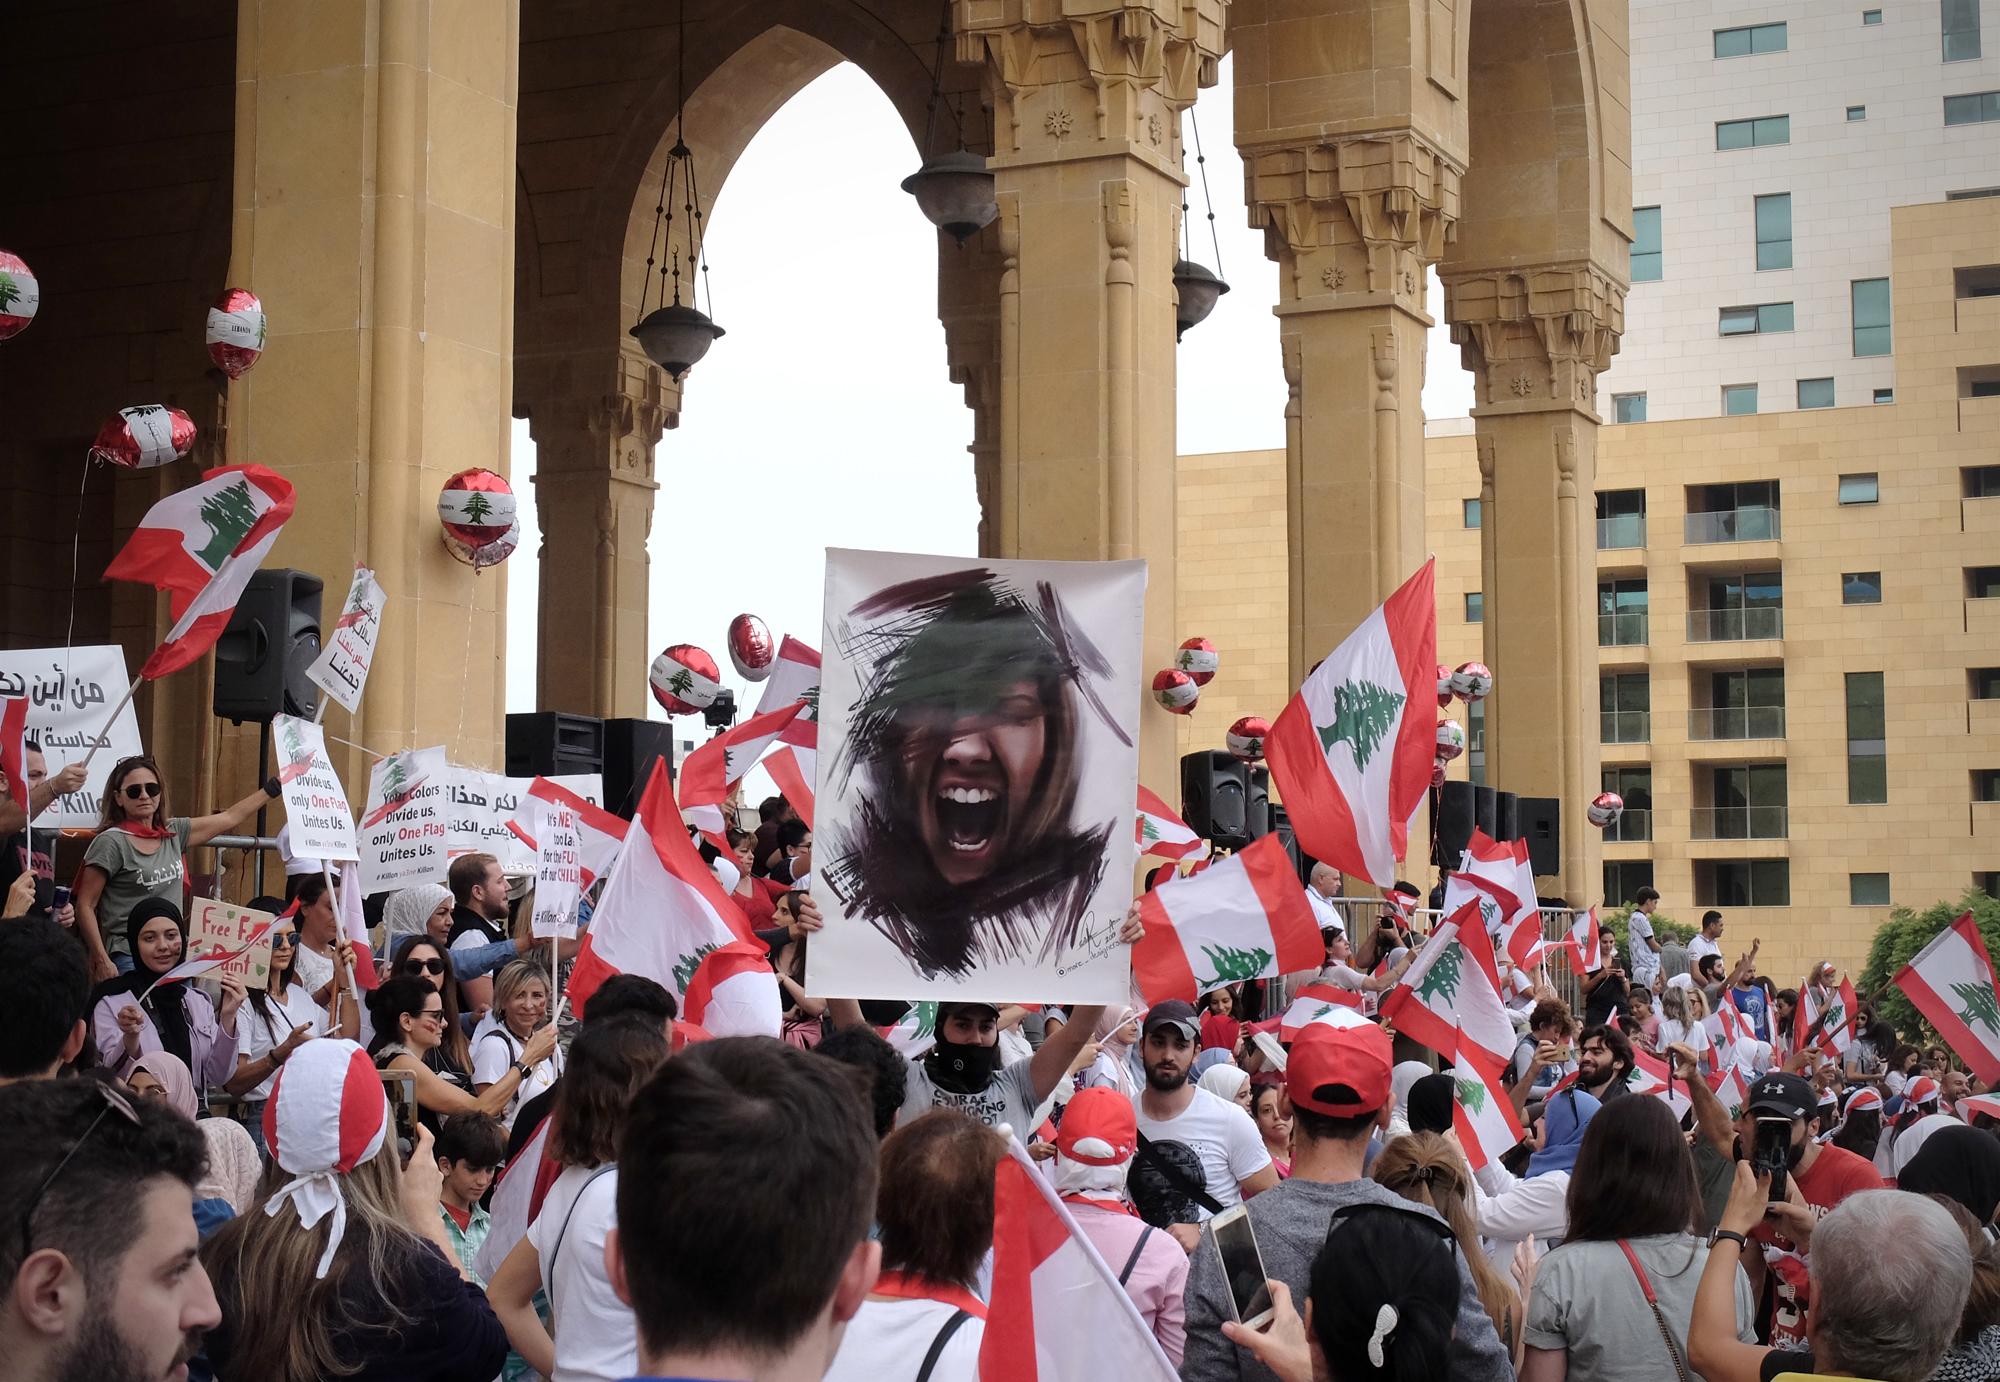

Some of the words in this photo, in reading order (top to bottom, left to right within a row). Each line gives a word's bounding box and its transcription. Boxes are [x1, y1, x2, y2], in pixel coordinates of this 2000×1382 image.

[231, 324, 251, 334] LEBANON
[32, 663, 66, 712] أين
[71, 677, 105, 710] من
[45, 727, 112, 754] محاسبة
[310, 755, 331, 771] olors
[296, 773, 325, 789] Divide
[323, 780, 335, 792] us,
[291, 794, 309, 810] only
[312, 794, 330, 809] One
[331, 796, 348, 813] Flag
[384, 791, 407, 805] Your
[408, 785, 440, 800] Colors
[446, 784, 487, 807] هذا
[492, 792, 518, 813] لكم
[302, 813, 330, 829] Unites
[330, 816, 346, 830] Us.
[386, 808, 418, 824] Divide
[421, 806, 436, 818] us,
[547, 811, 557, 828] It's
[558, 810, 574, 829] NE
[372, 831, 396, 846] only
[398, 827, 421, 841] One
[423, 823, 445, 837] Flag
[481, 823, 510, 841] يعني
[553, 832, 564, 847] too
[380, 847, 416, 863] Unites
[419, 843, 436, 857] Us.
[543, 848, 553, 863] for
[553, 850, 562, 864] the
[562, 850, 578, 865] FU
[381, 871, 399, 880] Killon
[417, 865, 434, 874] Killon
[541, 867, 548, 881] of
[557, 868, 578, 884] CHIL
[202, 906, 231, 937] Free
[237, 915, 269, 949] Fae
